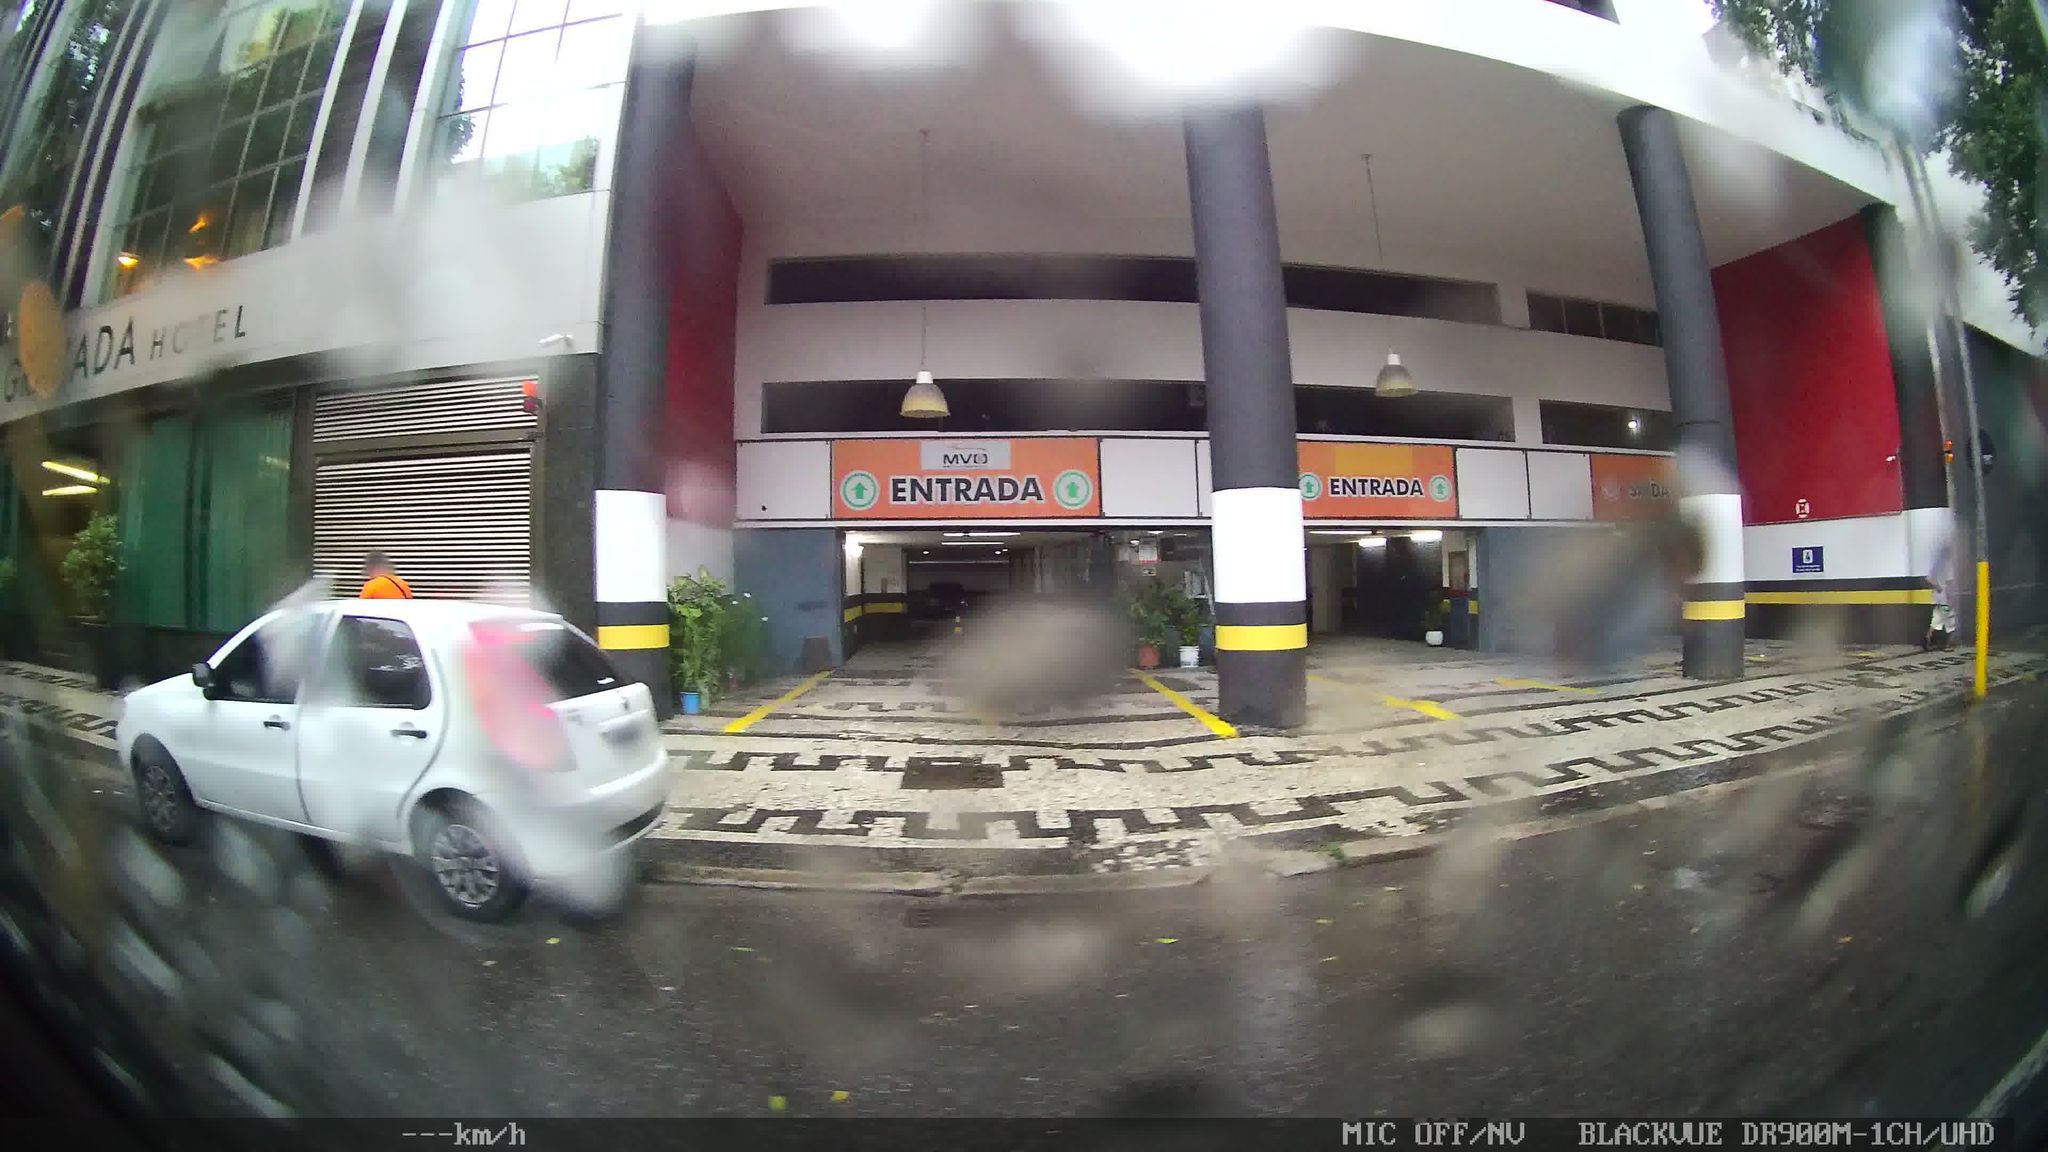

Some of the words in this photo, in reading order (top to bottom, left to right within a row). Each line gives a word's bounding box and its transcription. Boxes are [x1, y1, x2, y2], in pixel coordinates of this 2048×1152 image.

[150, 304, 246, 360] HOEL
[891, 477, 1044, 502] ENTRADA
[1330, 477, 1424, 498] ENTRADA
